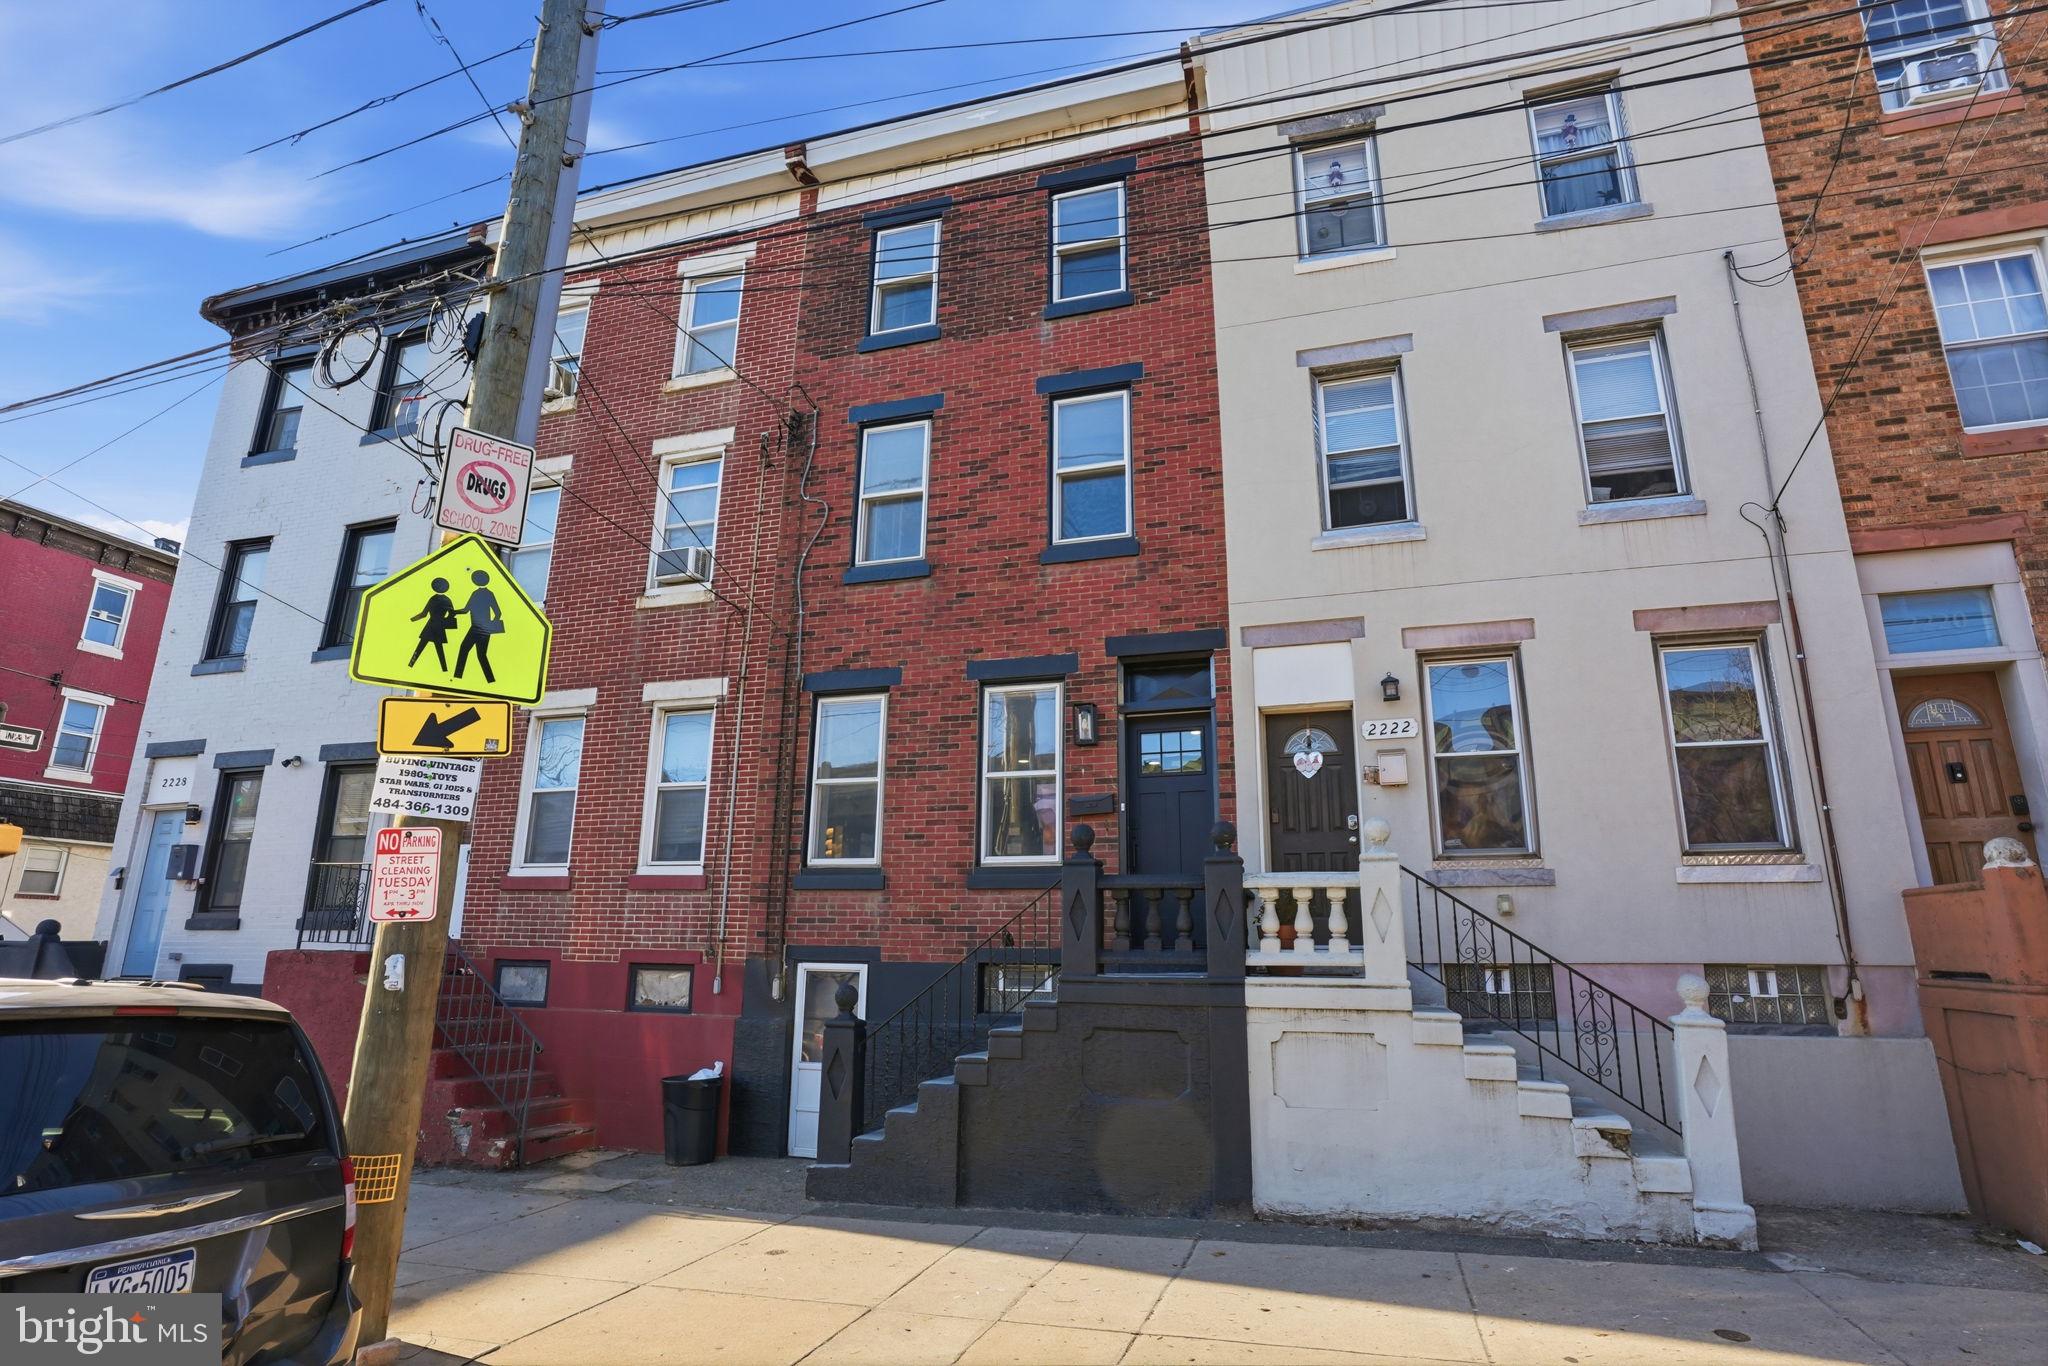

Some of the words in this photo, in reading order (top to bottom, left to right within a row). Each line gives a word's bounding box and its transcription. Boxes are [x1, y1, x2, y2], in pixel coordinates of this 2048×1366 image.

[455, 434, 529, 468] DRUG-FREE
[466, 472, 507, 500] DRUGS
[441, 508, 485, 532] SCHOOL
[489, 520, 518, 540] ZONE
[1367, 720, 1411, 736] 2222
[385, 756, 427, 767] BUYING
[430, 760, 476, 773] VINTAGE
[162, 776, 187, 788] 2228
[399, 769, 429, 779] 1980s
[431, 772, 458, 782] TOYS
[379, 777, 402, 786] STAR
[404, 780, 431, 789] WARS,
[444, 784, 465, 793] JOES
[388, 787, 461, 801] TRANSFORMERS
[373, 797, 470, 817] 484-366-1309
[379, 832, 399, 851] NO
[402, 835, 437, 848] PARKING
[389, 855, 425, 865] STREET
[381, 866, 431, 875] CLEANING
[377, 876, 433, 888] TUESDAY
